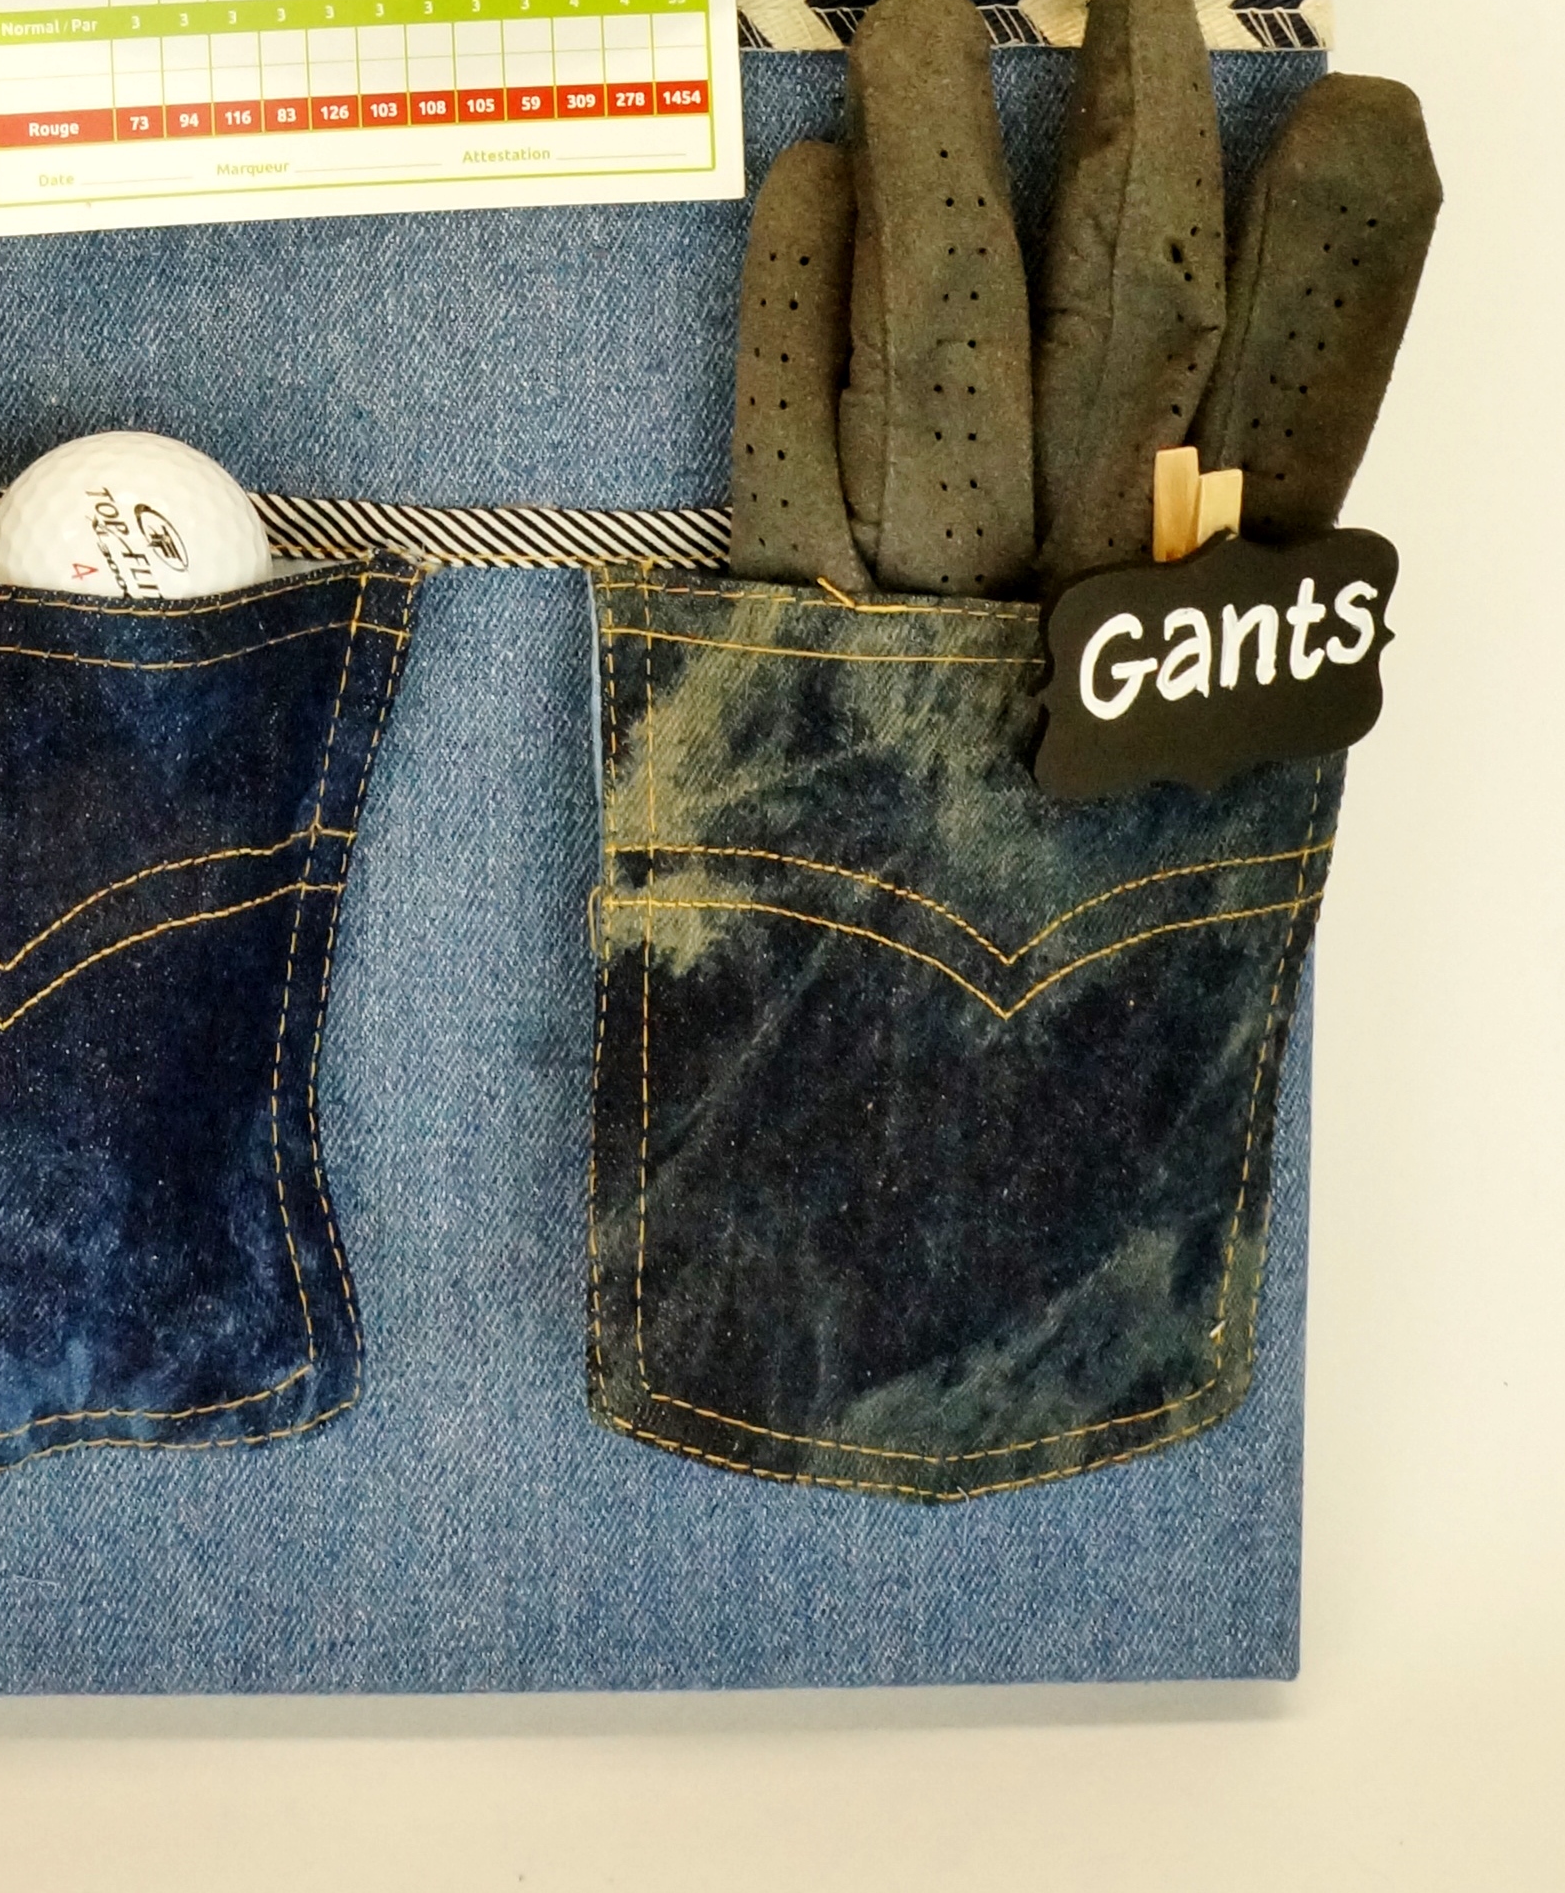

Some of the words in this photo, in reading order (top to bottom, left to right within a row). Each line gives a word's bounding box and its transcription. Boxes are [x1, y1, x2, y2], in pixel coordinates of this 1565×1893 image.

[1, 21, 60, 37] Normal
[70, 19, 98, 33] Par
[132, 15, 140, 29] 3
[180, 13, 189, 27] 3
[228, 11, 237, 24] 3
[276, 7, 286, 21] 3
[326, 5, 334, 19] 3
[376, 3, 384, 17] 3
[424, 1, 433, 15] 3
[472, 0, 481, 13] 3
[28, 121, 80, 139] Rouge
[130, 116, 148, 131] 73
[179, 113, 199, 128] 94
[224, 111, 252, 125] 116
[276, 107, 296, 123] 83
[320, 105, 350, 120] 126
[370, 103, 398, 117] 103
[418, 101, 446, 115] 108
[466, 98, 496, 113] 105
[520, 95, 542, 111] 59
[566, 93, 596, 109] 309
[616, 91, 646, 107] 278
[662, 89, 702, 105] 1454
[38, 173, 75, 187] Date
[216, 161, 290, 177] Marqueur
[462, 147, 550, 164] Attestation
[85, 487, 129, 537] TOP
[72, 563, 99, 580] 4
[1079, 578, 1378, 720] Gants
